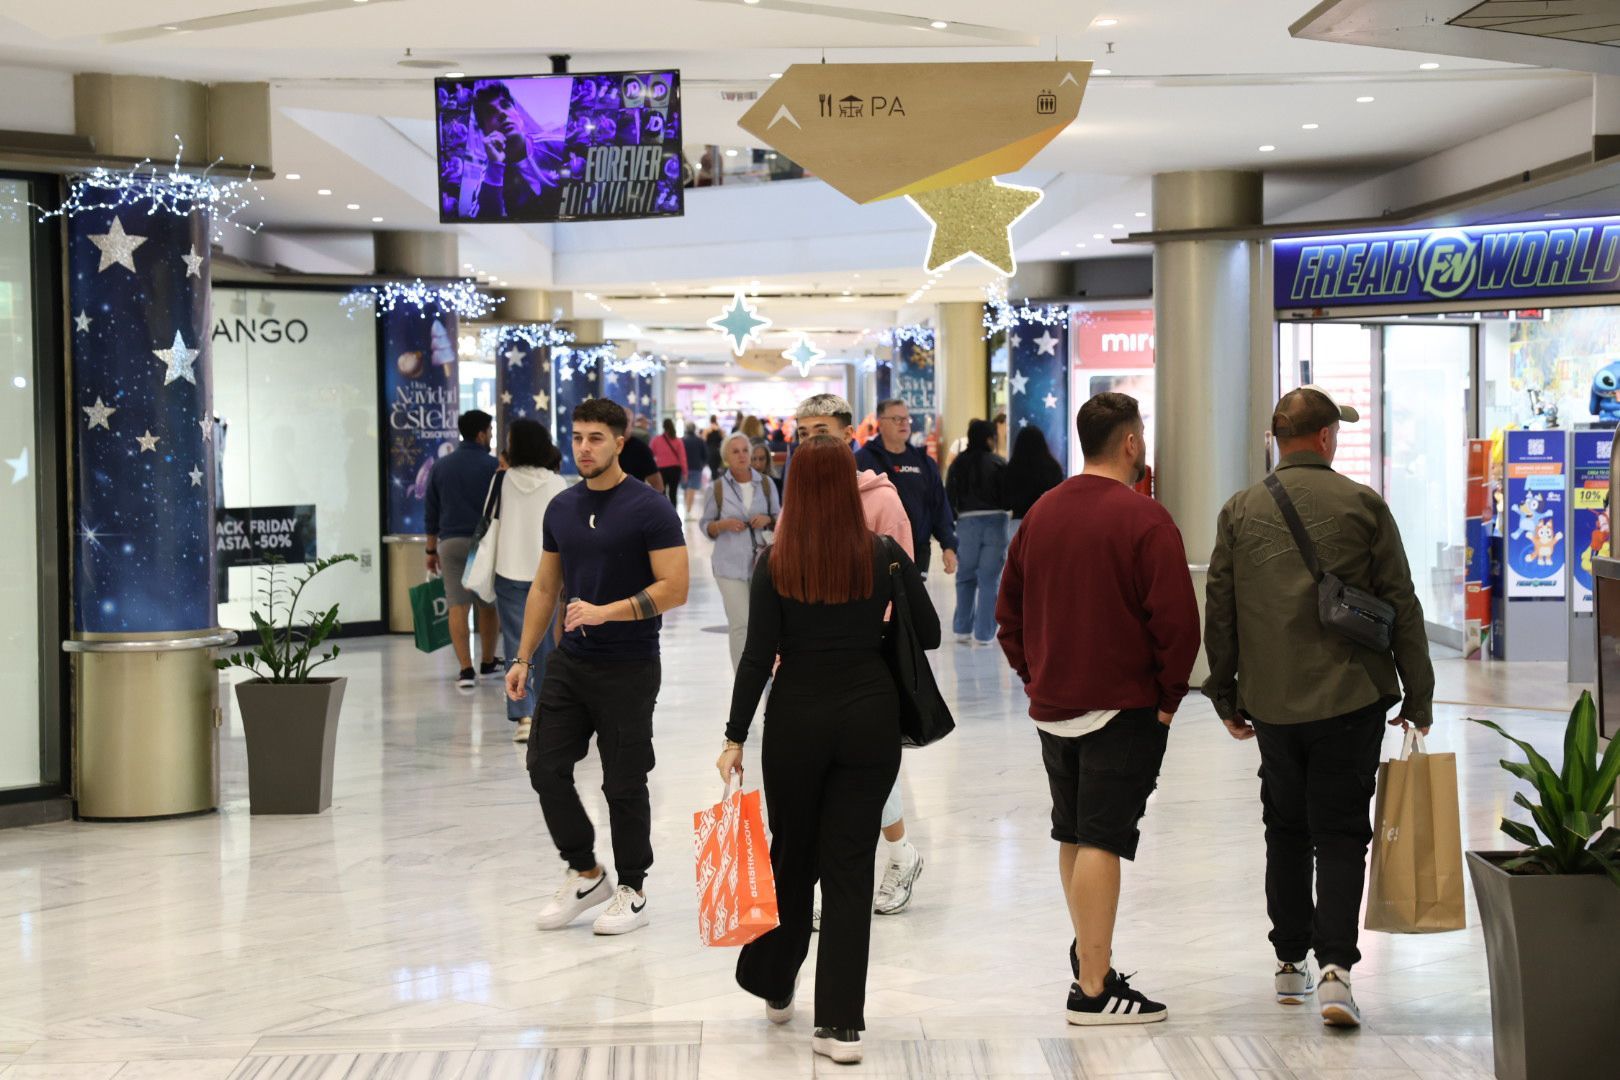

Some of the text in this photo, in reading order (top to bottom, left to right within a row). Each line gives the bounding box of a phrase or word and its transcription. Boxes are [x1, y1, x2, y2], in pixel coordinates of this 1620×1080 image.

[871, 95, 906, 117] PA
[585, 145, 663, 182] FOREVER
[1290, 238, 1420, 300] FREAK
[1477, 224, 1620, 291] WORLD
[212, 318, 308, 344] ANGO
[390, 400, 459, 430] Estela
[1580, 490, 1601, 500] 10%
[216, 518, 297, 535] ACK FRIDAY
[216, 533, 292, 551] ASTA -50%
